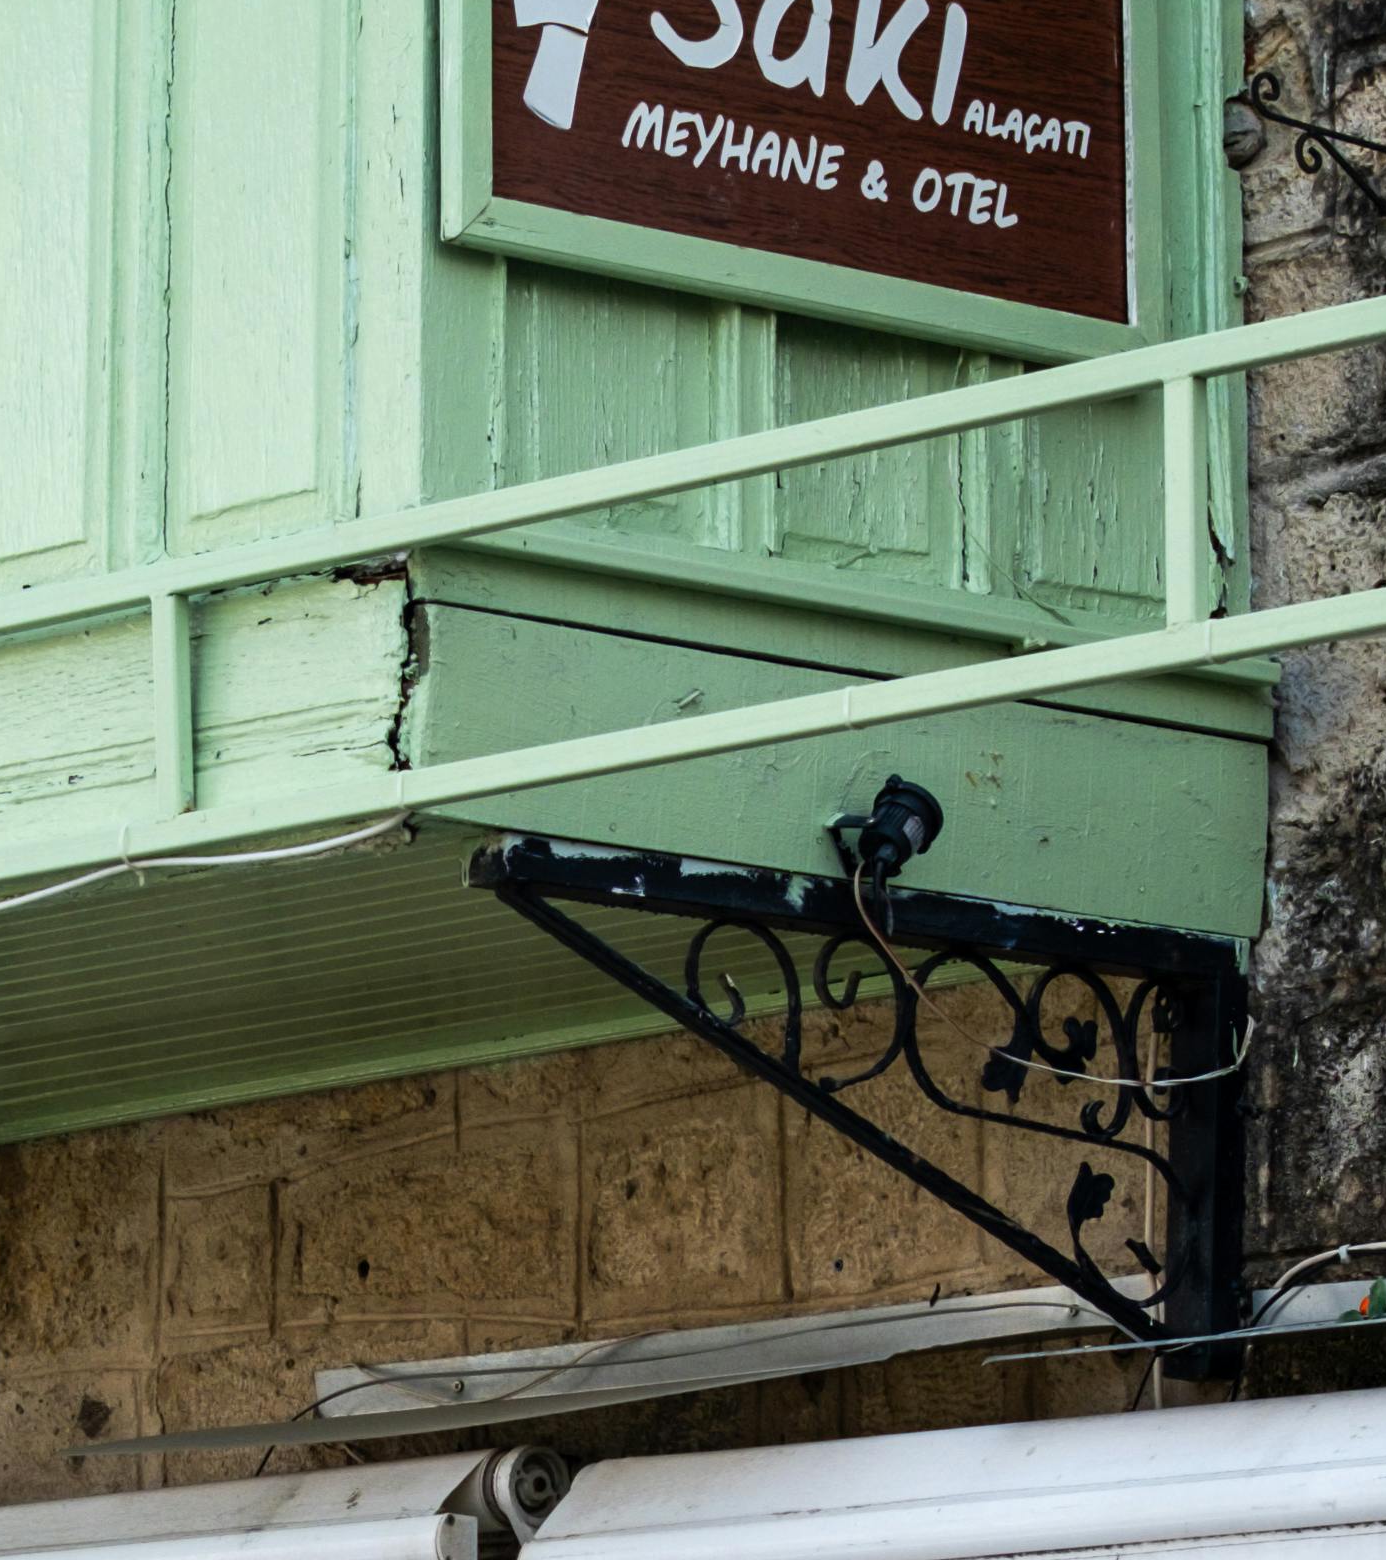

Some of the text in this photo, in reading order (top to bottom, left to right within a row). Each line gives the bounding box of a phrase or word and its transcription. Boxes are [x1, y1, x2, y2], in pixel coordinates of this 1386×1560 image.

[621, 101, 1019, 228] MEYHANE & OTEL
[963, 98, 1091, 159] ALAÇATI
